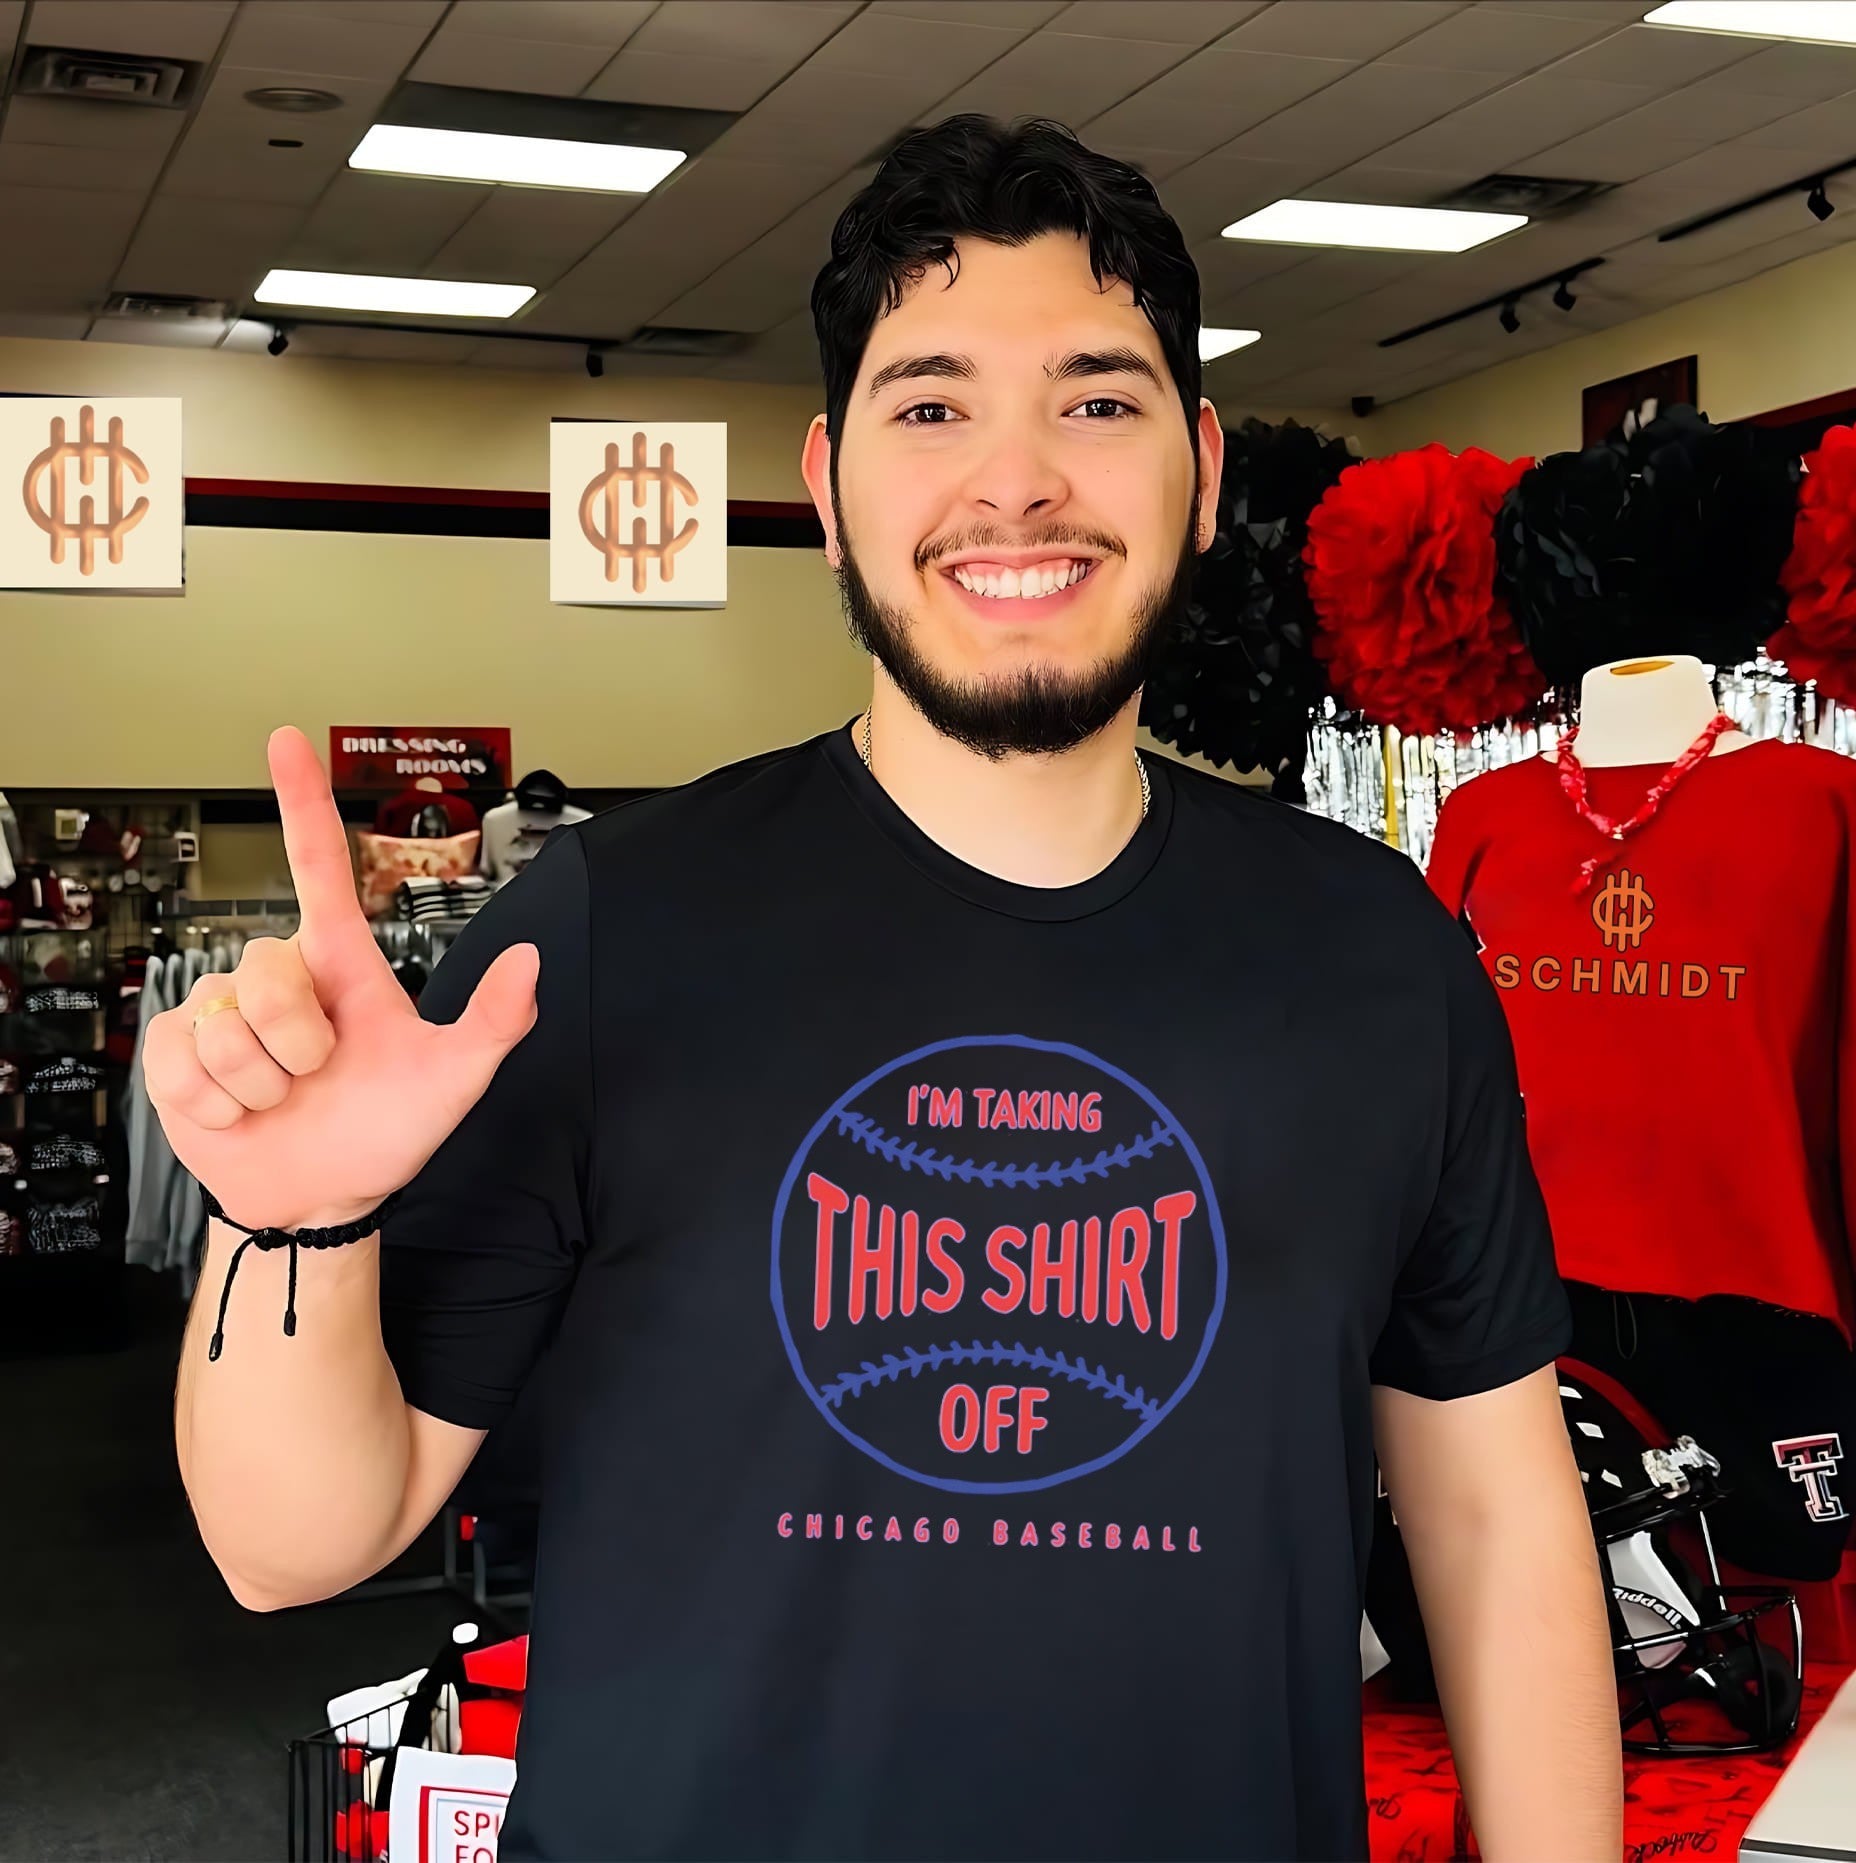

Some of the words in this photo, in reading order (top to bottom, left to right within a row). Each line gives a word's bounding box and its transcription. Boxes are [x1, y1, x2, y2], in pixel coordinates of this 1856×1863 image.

[396, 758, 487, 774] ROOMS
[1494, 954, 1747, 1000] SCHMIDT
[907, 1084, 963, 1129] I'M
[973, 1087, 1103, 1133] TAKING
[807, 1172, 966, 1331] THIS
[981, 1190, 1197, 1341] SHIRT
[939, 1383, 1050, 1454] OFF
[777, 1512, 960, 1543] CHICAGO
[992, 1519, 1202, 1552] BASEBALL
